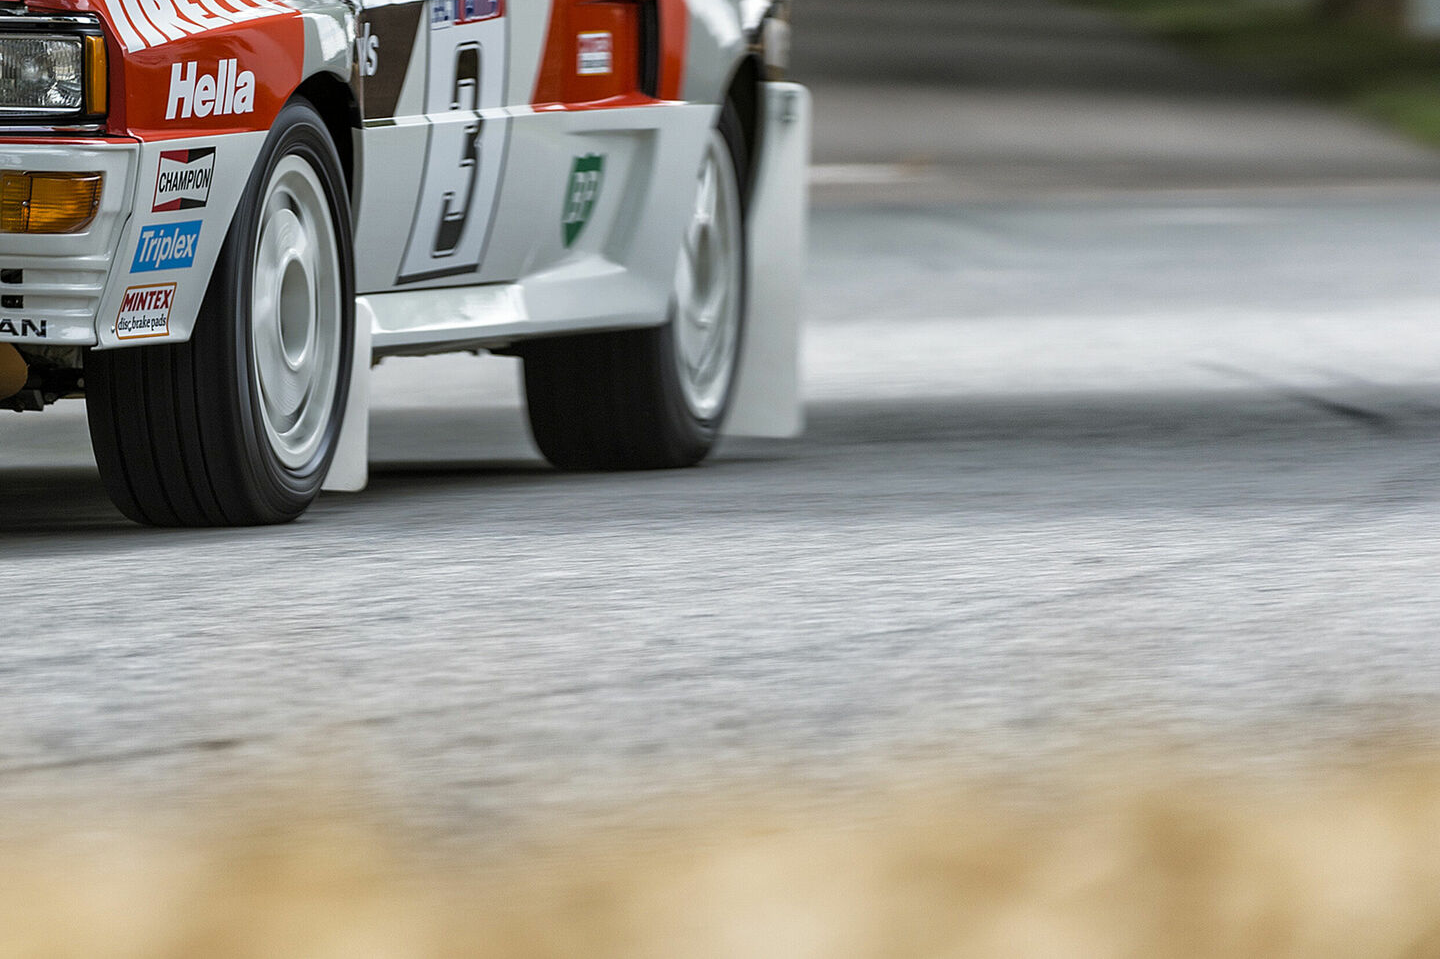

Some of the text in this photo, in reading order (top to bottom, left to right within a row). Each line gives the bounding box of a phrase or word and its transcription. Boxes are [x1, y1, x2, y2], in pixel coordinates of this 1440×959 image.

[165, 58, 255, 120] Hella
[159, 168, 210, 193] CHAMPION
[138, 227, 196, 268] Triplex
[121, 289, 172, 312] MINTEX
[132, 315, 150, 329] brake
[151, 313, 167, 331] pads
